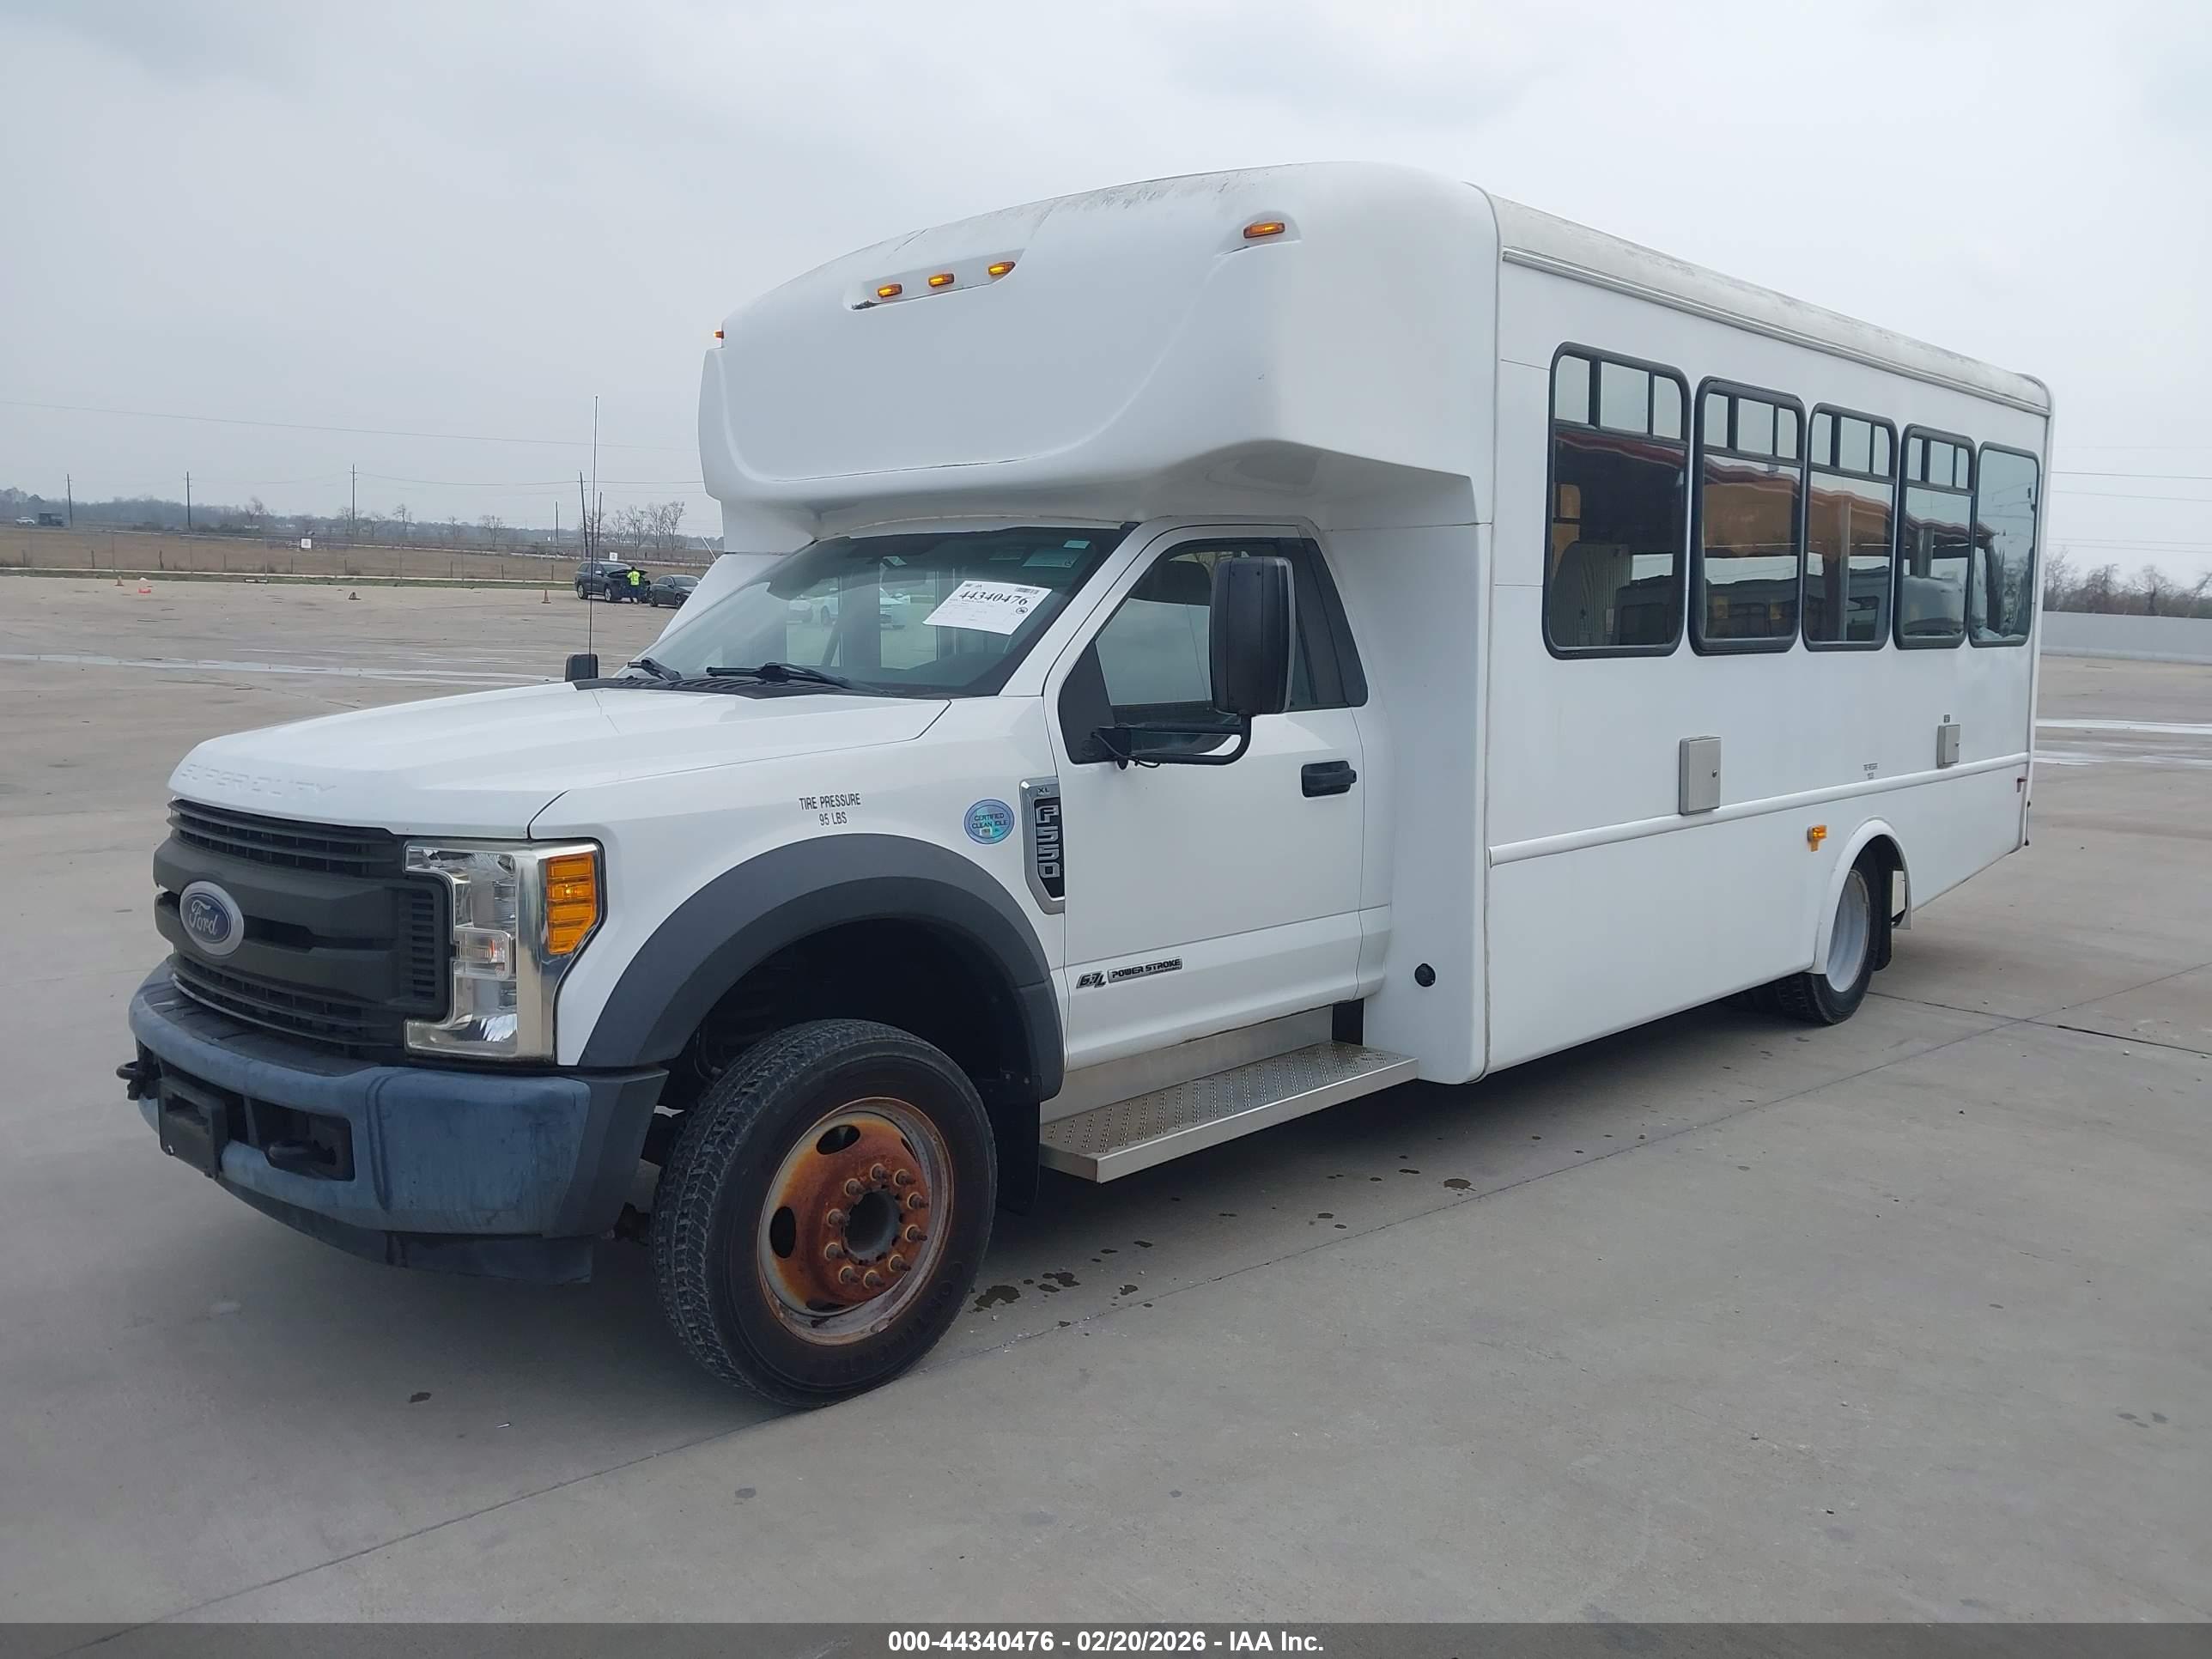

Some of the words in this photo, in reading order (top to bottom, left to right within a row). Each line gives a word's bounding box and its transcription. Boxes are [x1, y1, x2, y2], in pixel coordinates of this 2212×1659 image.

[959, 590, 1030, 606] 44340476
[799, 797, 817, 810] TIRE
[819, 793, 861, 808] PRESSURE
[819, 813, 830, 826] 95
[831, 811, 848, 824] LBS
[975, 812, 1005, 821] CERTIFIED
[971, 821, 993, 830] CLEAN
[1036, 805, 1060, 878] F550
[189, 899, 219, 936] Ford
[1077, 972, 1106, 988] 6.7L
[1111, 967, 1144, 979] POWER
[1145, 958, 1181, 972] STROKE
